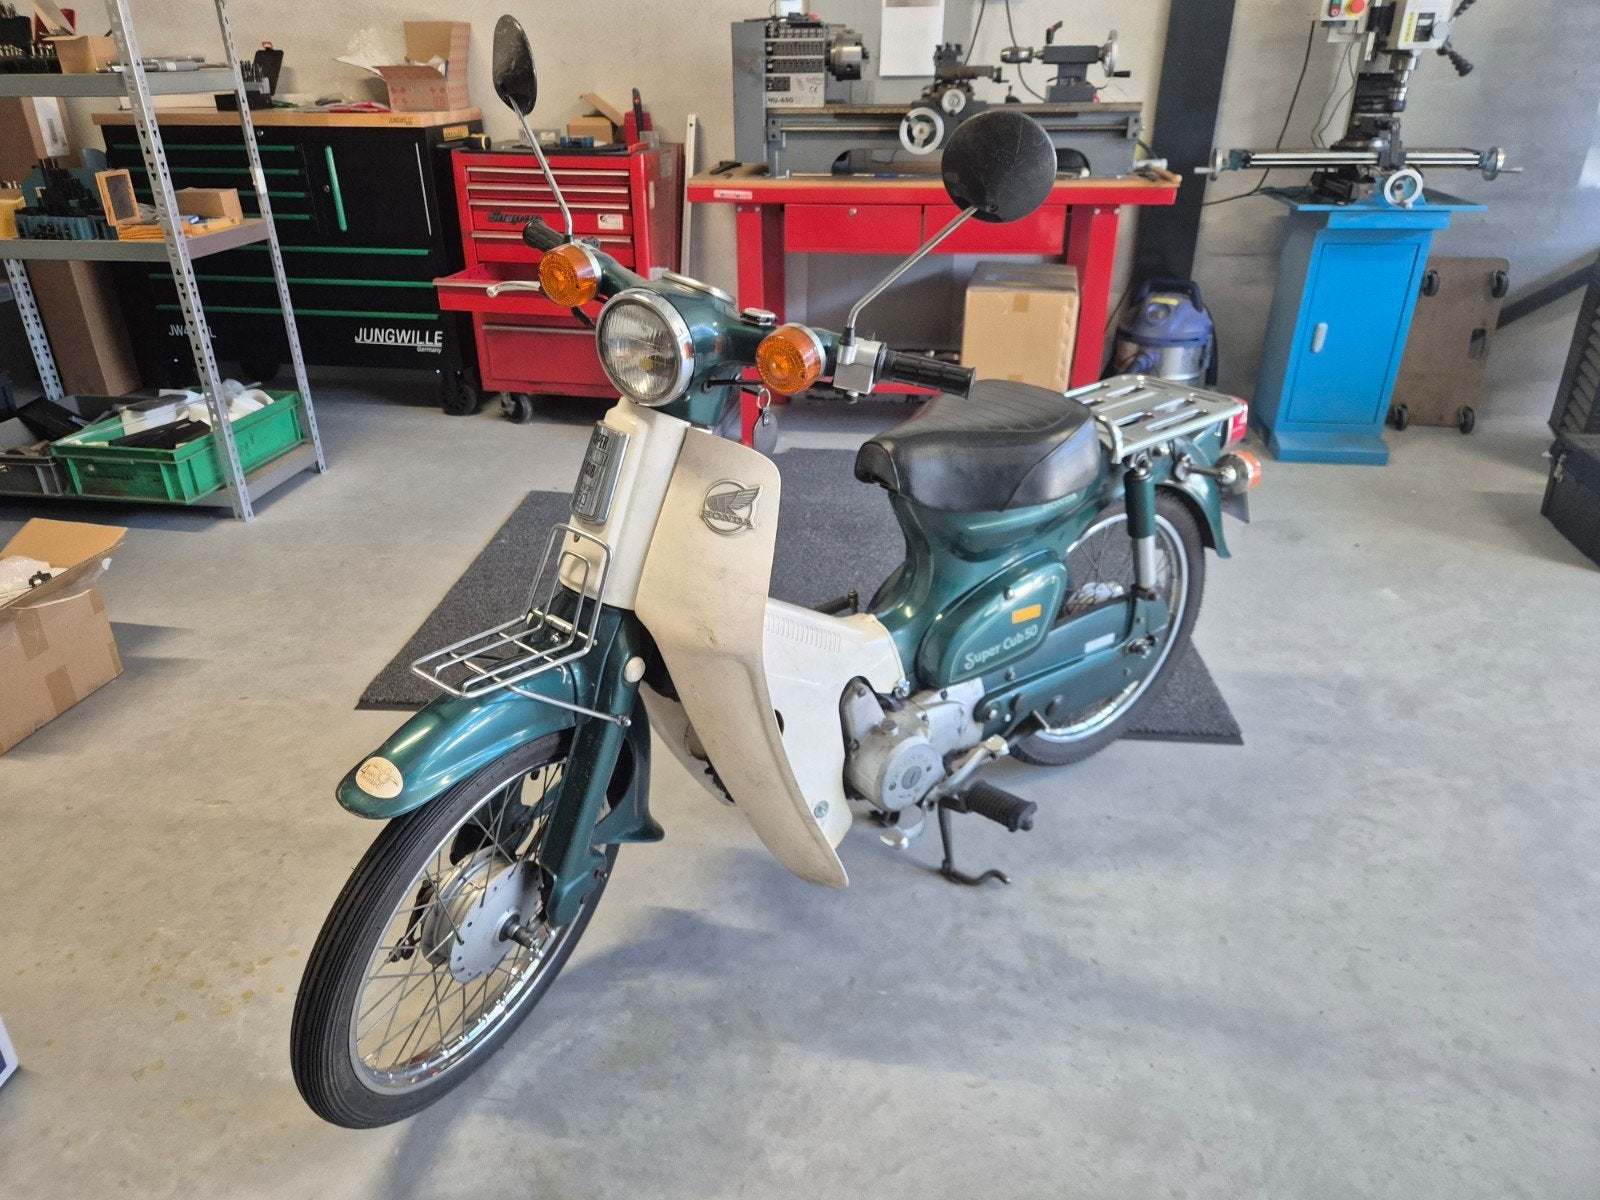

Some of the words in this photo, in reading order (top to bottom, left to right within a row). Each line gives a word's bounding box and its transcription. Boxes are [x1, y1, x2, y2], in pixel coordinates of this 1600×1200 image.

[354, 327, 443, 346] JUNGWILLE
[416, 345, 442, 354] Germany
[702, 510, 753, 529] HONDA
[964, 644, 1001, 670] Super
